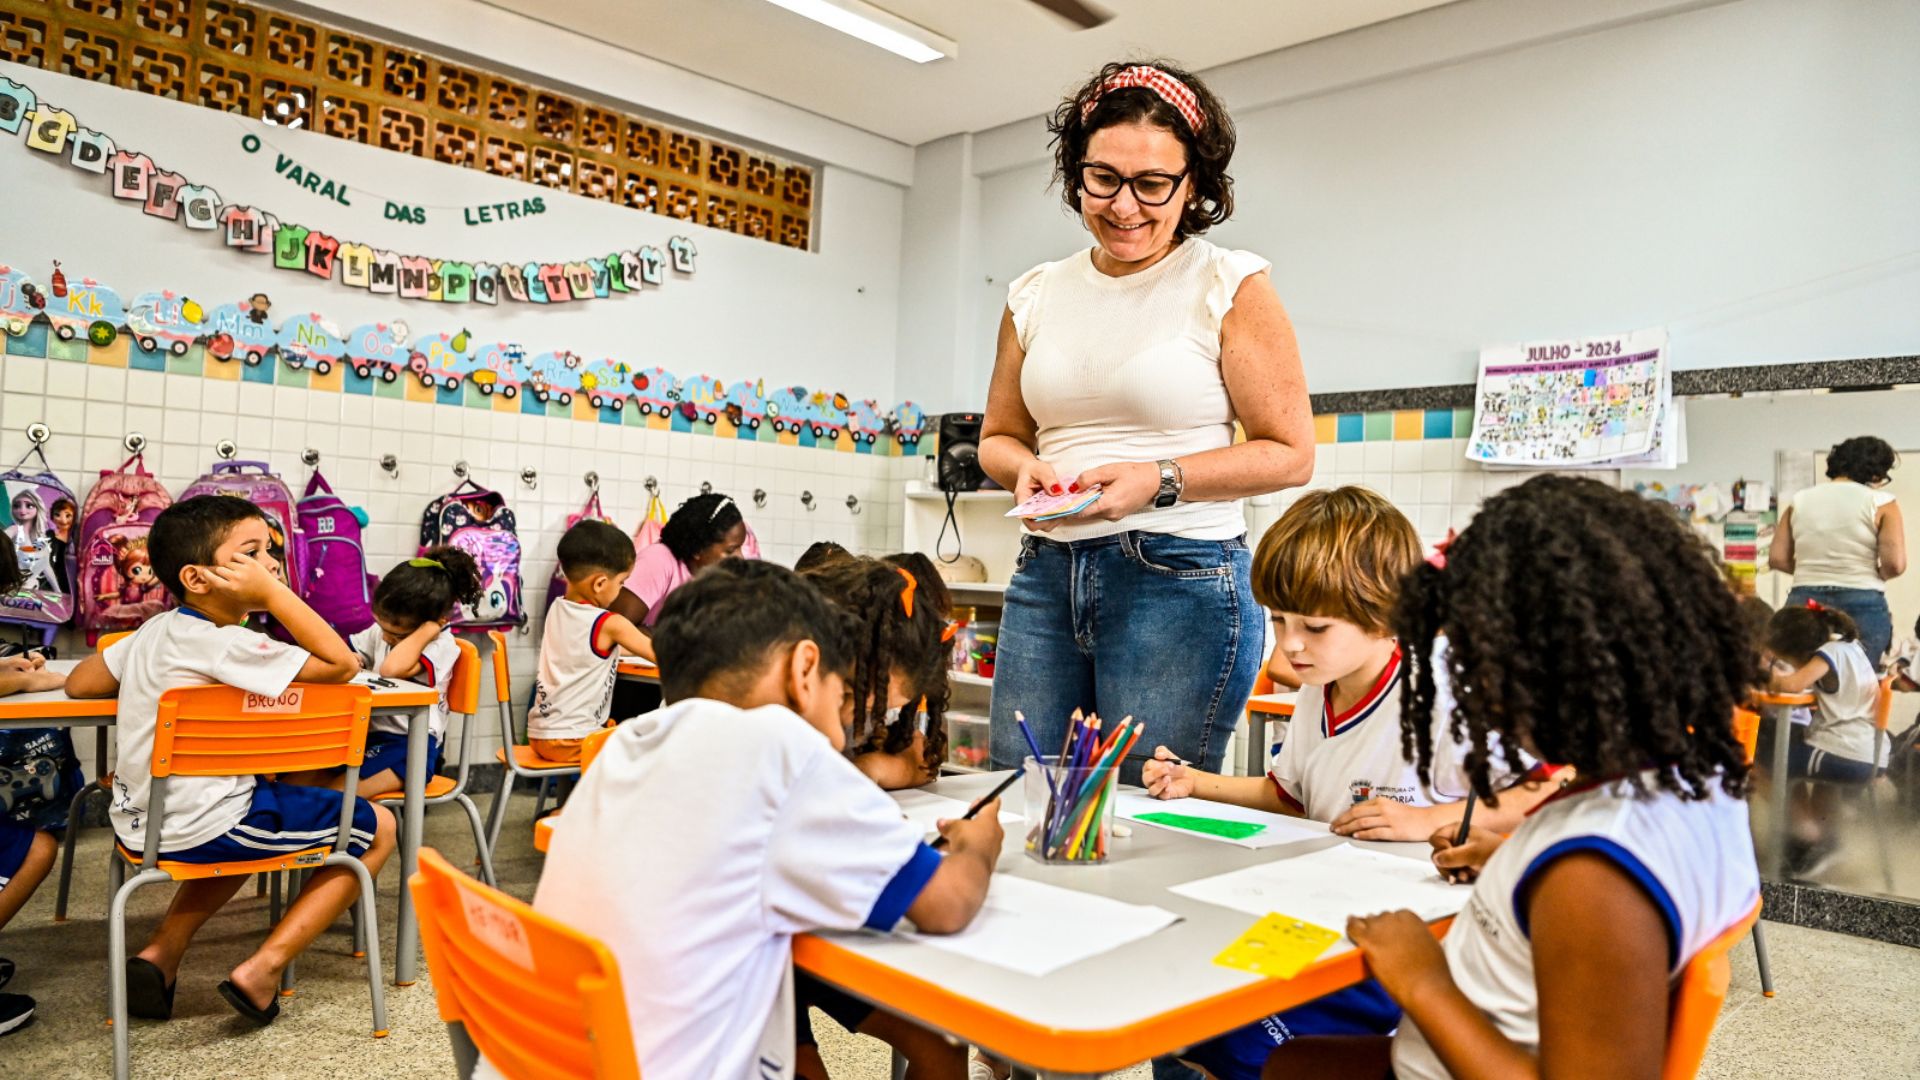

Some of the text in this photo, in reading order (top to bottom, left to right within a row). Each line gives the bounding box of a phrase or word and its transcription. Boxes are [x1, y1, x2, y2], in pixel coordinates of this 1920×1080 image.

[241, 134, 547, 226] O VARAL DAS LETRAS
[0, 92, 20, 122] B
[38, 120, 62, 144] C
[78, 141, 102, 162] D
[122, 165, 141, 190] E
[153, 182, 174, 207] F
[188, 198, 212, 221] G
[232, 218, 254, 240] H
[281, 238, 300, 261] J
[312, 244, 331, 270] K
[349, 255, 363, 276] L
[371, 262, 394, 285] M
[403, 268, 424, 289] N
[427, 273, 441, 292] O
[448, 273, 466, 294] P
[479, 275, 495, 298] Q
[508, 274, 523, 294] R
[547, 275, 562, 294] T
[571, 273, 589, 292] U
[593, 271, 606, 289] V
[626, 262, 639, 281] X
[646, 258, 658, 275] Y
[678, 247, 690, 265] Z
[68, 288, 103, 317] Kk
[219, 311, 263, 338] Mm
[297, 322, 327, 348] Nn
[364, 332, 394, 356] Oo
[430, 341, 457, 370] Pp
[1526, 344, 1571, 362] JULHO
[1585, 339, 1622, 358] 2024
[487, 352, 515, 378] Qq
[598, 367, 619, 387] Ss
[247, 692, 299, 708] BRUNO
